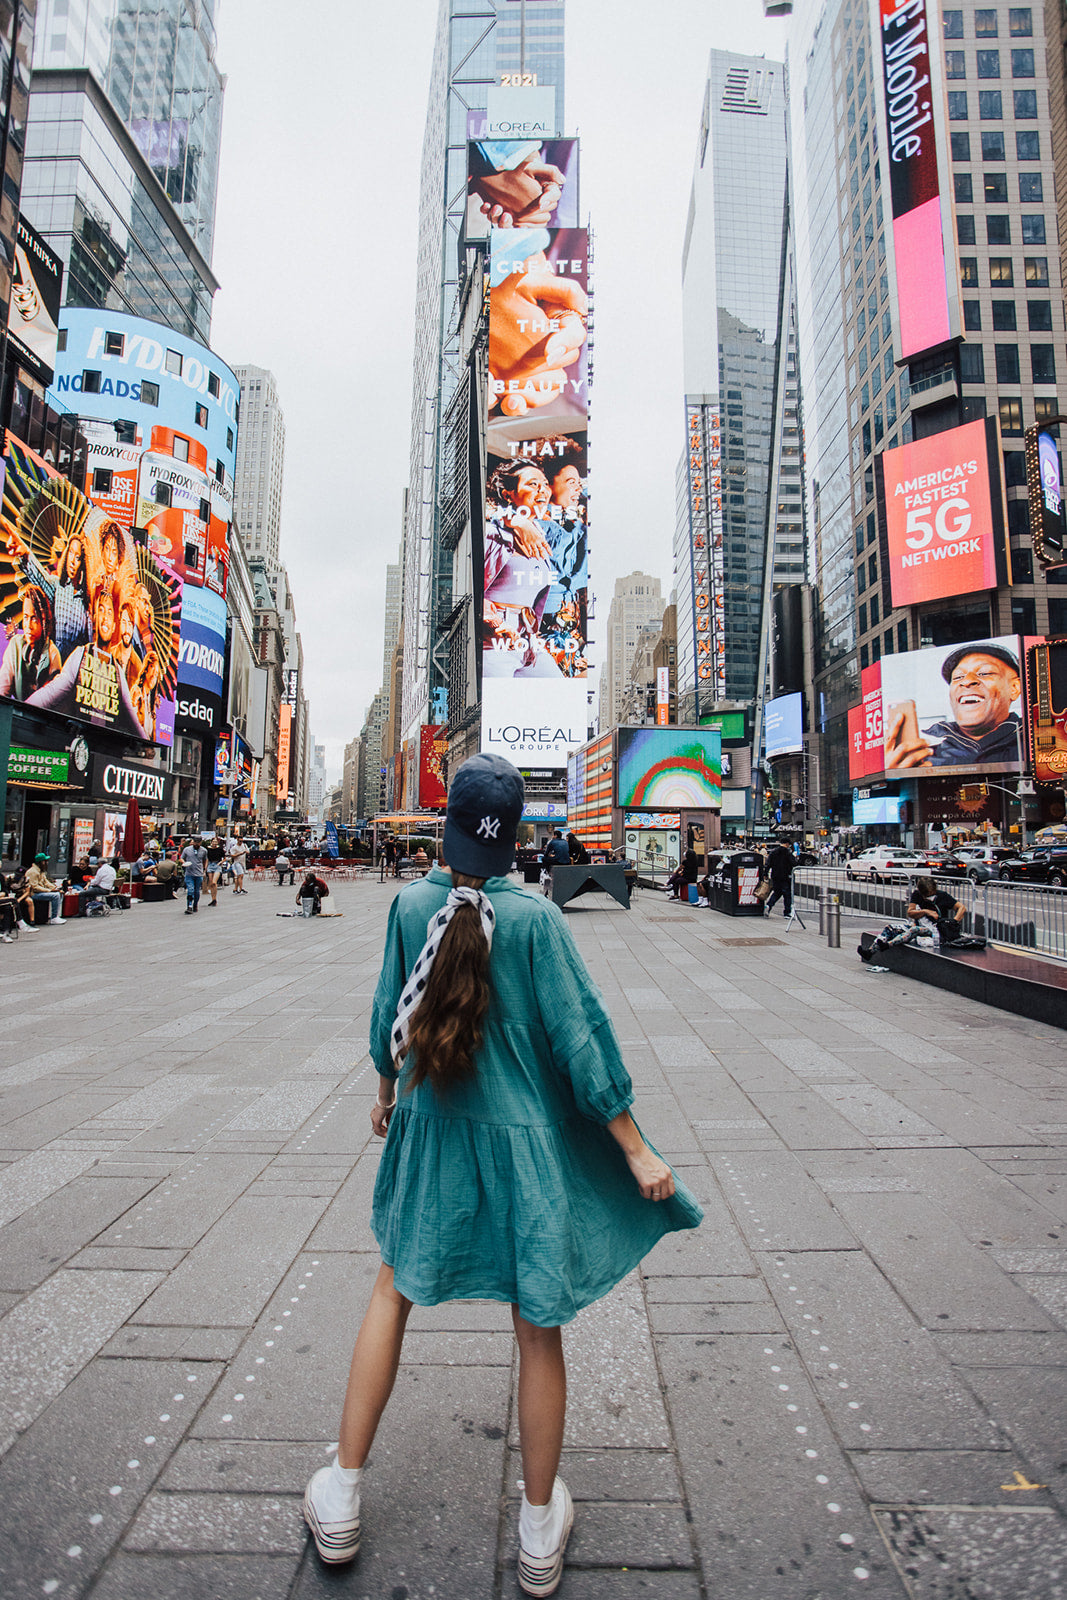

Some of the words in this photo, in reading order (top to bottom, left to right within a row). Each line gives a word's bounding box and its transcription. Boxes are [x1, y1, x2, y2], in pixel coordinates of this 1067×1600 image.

[501, 73, 537, 87] 2021
[33, 240, 58, 276] RIPKA
[496, 260, 583, 274] CREATE
[516, 319, 561, 333] THE
[57, 374, 83, 393] NO
[493, 379, 585, 394] BEAUTY
[507, 441, 568, 457] THAT
[690, 414, 703, 511] ERNST
[112, 476, 134, 492] OSE
[150, 466, 206, 496] HYDROXYCUT
[894, 460, 978, 497] AMERICA'S
[904, 479, 969, 509] FASTEST
[497, 504, 578, 520] MOVES
[905, 497, 972, 549] 5G
[694, 533, 706, 548] &
[901, 537, 981, 569] NETWORK
[513, 570, 559, 586] THE
[695, 570, 711, 679] YOUNG
[491, 637, 580, 653] WORLD
[84, 653, 116, 682] DEAR
[79, 667, 119, 699] WHITE
[288, 671, 298, 698] Locker
[75, 684, 119, 716] PEOPLE
[489, 726, 581, 743] L'ORÉAL
[865, 709, 882, 739] 5G
[7, 763, 52, 775] COFFEE
[1038, 753, 1060, 764] Hard
[103, 764, 165, 800] CITIZEN
[476, 815, 501, 839] NY
